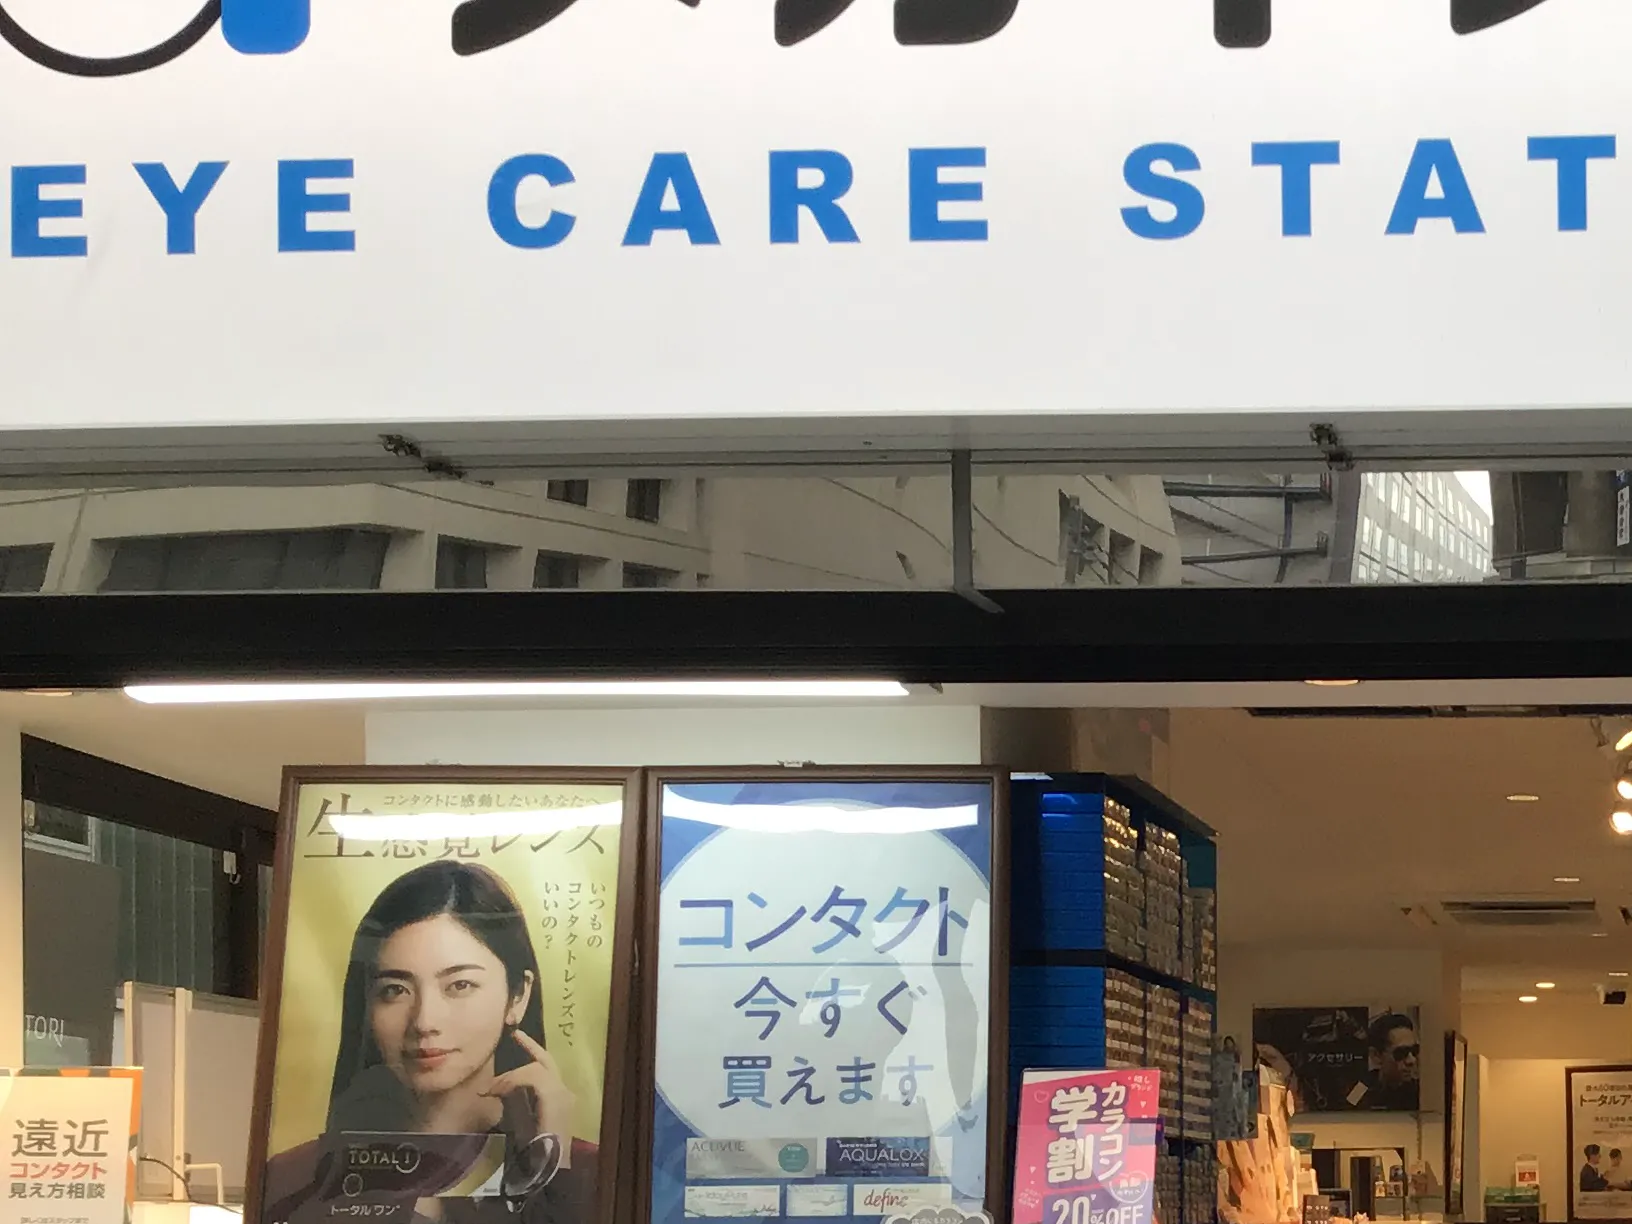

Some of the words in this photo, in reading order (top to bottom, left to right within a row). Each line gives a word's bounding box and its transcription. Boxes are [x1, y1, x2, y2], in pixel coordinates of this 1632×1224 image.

[10, 158, 357, 258] EYE
[486, 146, 989, 251] CARE
[587, 881, 606, 949] いつもの
[678, 885, 969, 957] コンタクト
[733, 976, 930, 1041] 今すぐ
[718, 1056, 935, 1109] 買えます
[1307, 1052, 1364, 1062] アクセサリー
[11, 1118, 109, 1158] 遠近
[348, 1150, 399, 1164] TOTAL
[839, 1148, 926, 1163] AQUALOX
[1047, 1085, 1098, 1184] 学割
[1097, 1081, 1127, 1182] カラコン
[8, 1182, 106, 1200] 見え方相談
[9, 1161, 108, 1181] コンタクト
